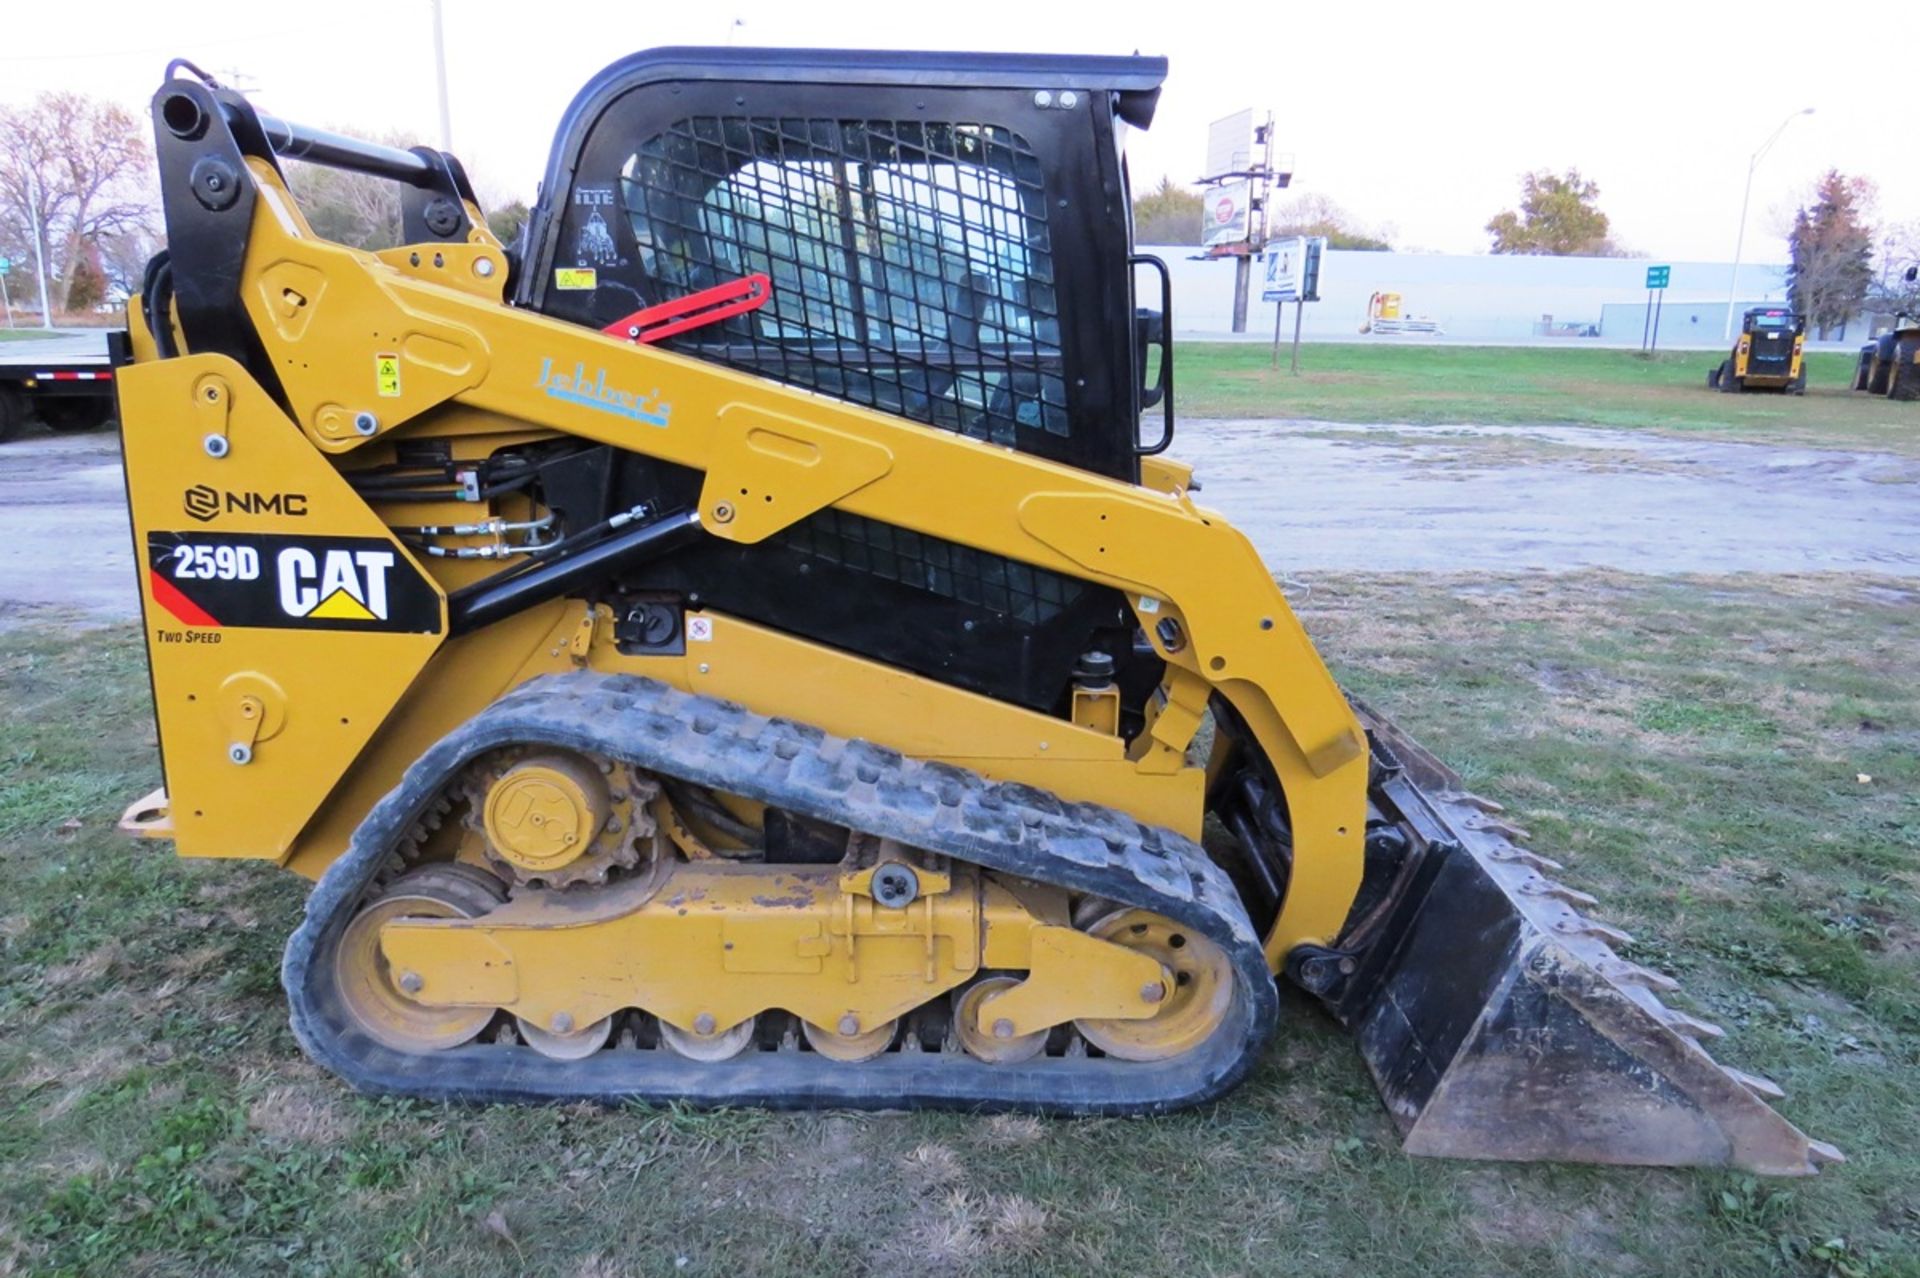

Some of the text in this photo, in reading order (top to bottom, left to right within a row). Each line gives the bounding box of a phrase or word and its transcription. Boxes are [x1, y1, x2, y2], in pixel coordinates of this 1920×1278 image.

[227, 492, 308, 516] NMC
[174, 545, 260, 580] 259D
[277, 547, 394, 620] CAT
